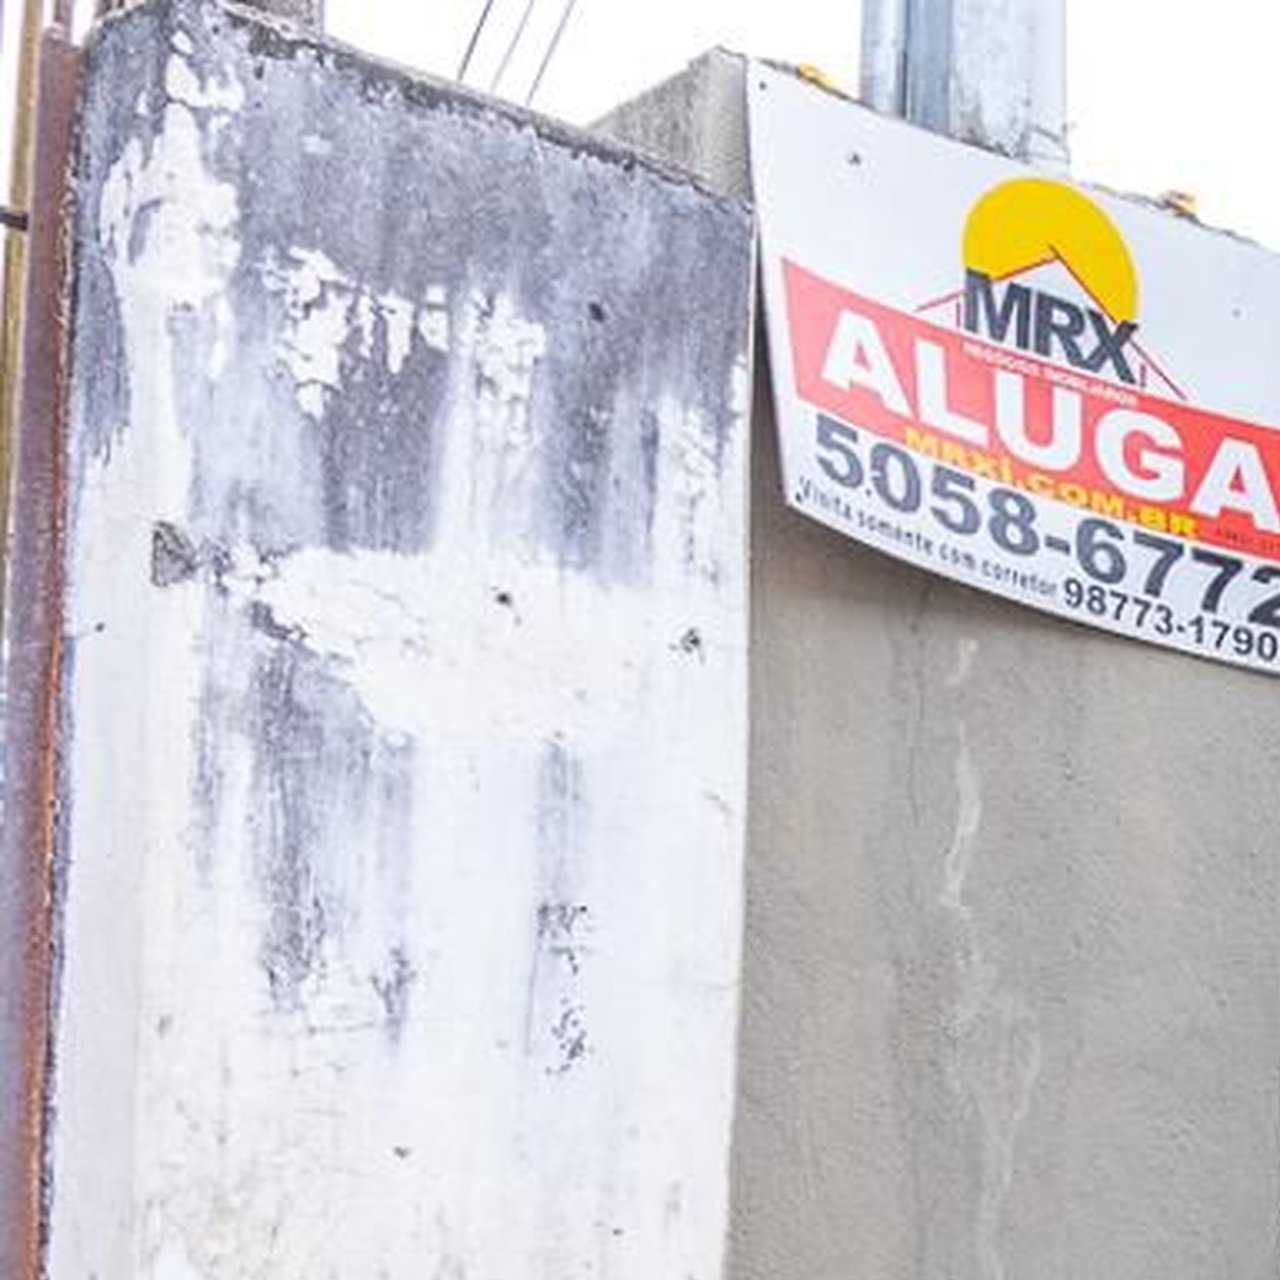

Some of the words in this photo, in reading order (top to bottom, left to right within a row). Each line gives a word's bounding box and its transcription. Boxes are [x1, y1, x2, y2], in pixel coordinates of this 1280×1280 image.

[964, 268, 1138, 385] MRX
[856, 510, 934, 557] somente
[938, 543, 977, 571] com
[980, 557, 1059, 597] corretor
[1063, 576, 1279, 663] 98773-1790
